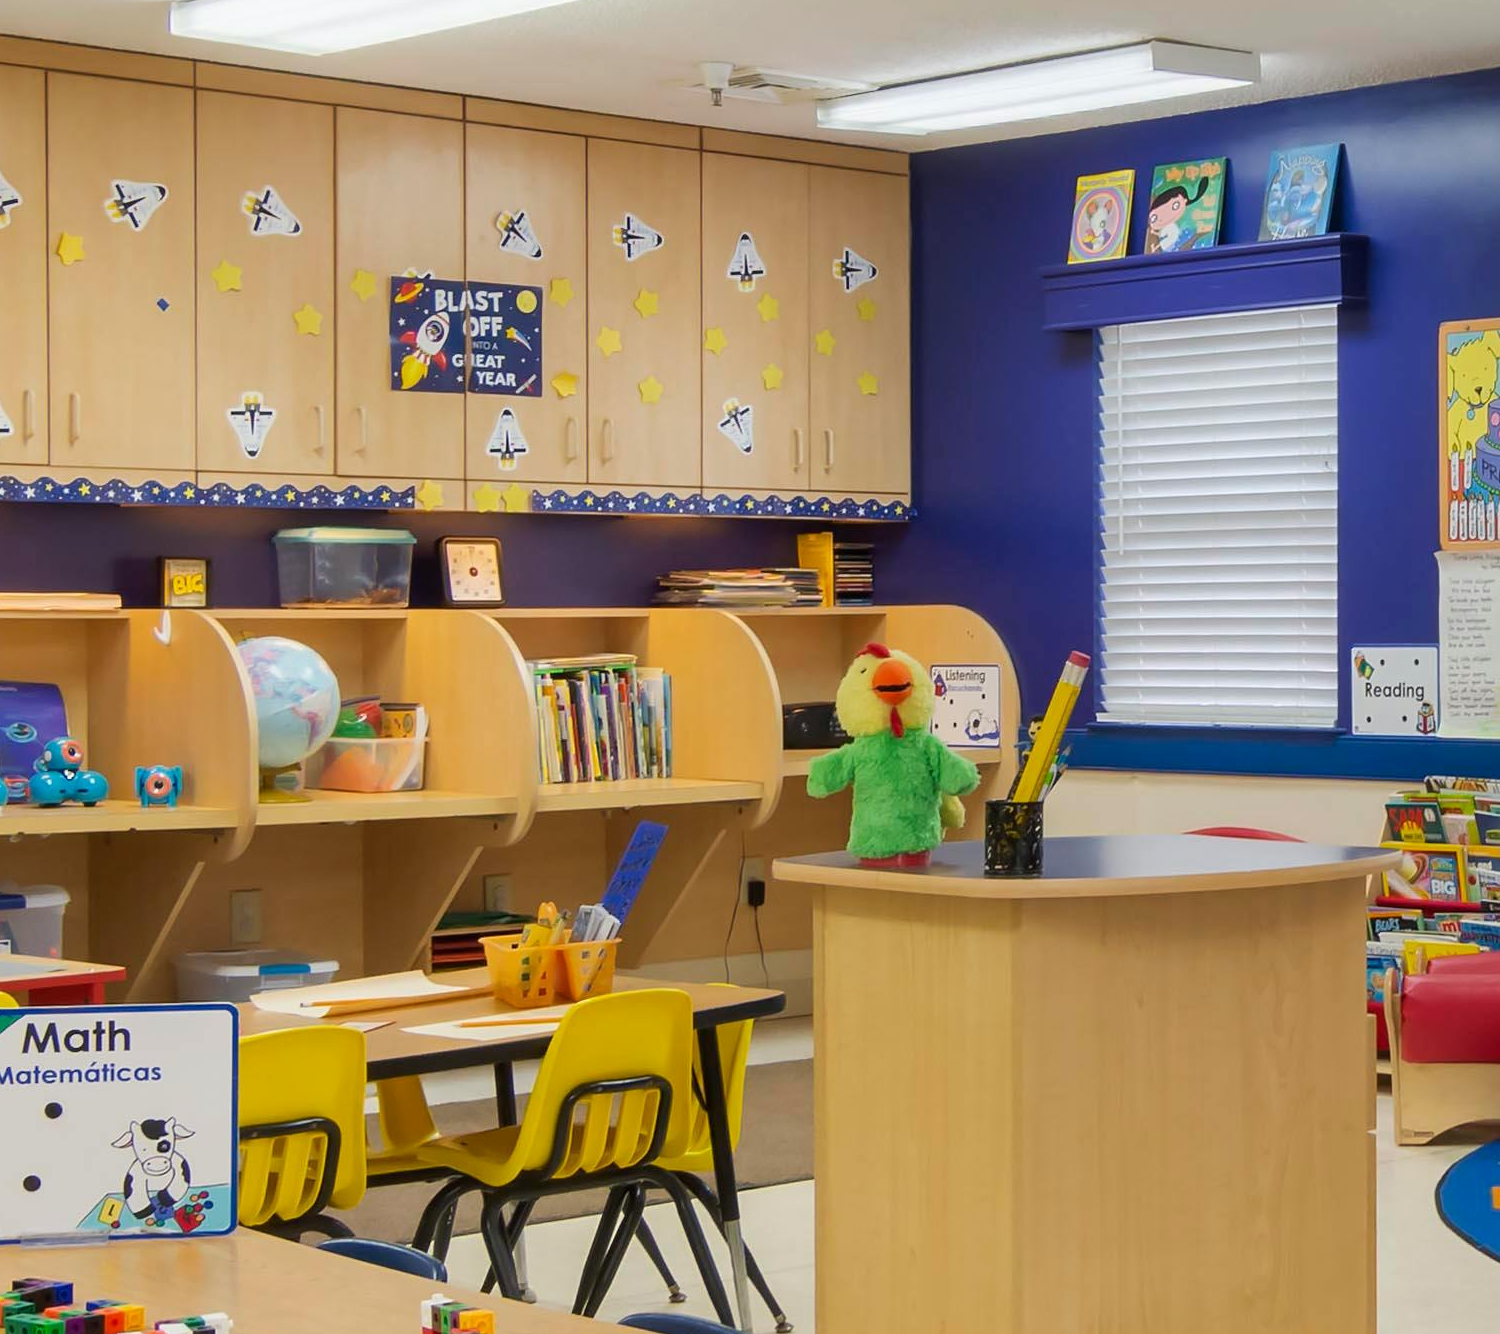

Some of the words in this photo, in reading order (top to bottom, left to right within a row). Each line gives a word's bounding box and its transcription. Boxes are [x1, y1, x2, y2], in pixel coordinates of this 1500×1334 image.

[435, 289, 503, 312] BLAST
[463, 316, 504, 338] OFF
[476, 370, 517, 387] YEAR
[945, 669, 986, 684] Listening
[1365, 682, 1425, 702] Reading
[1430, 879, 1456, 895] BIG
[22, 1020, 132, 1054] Math
